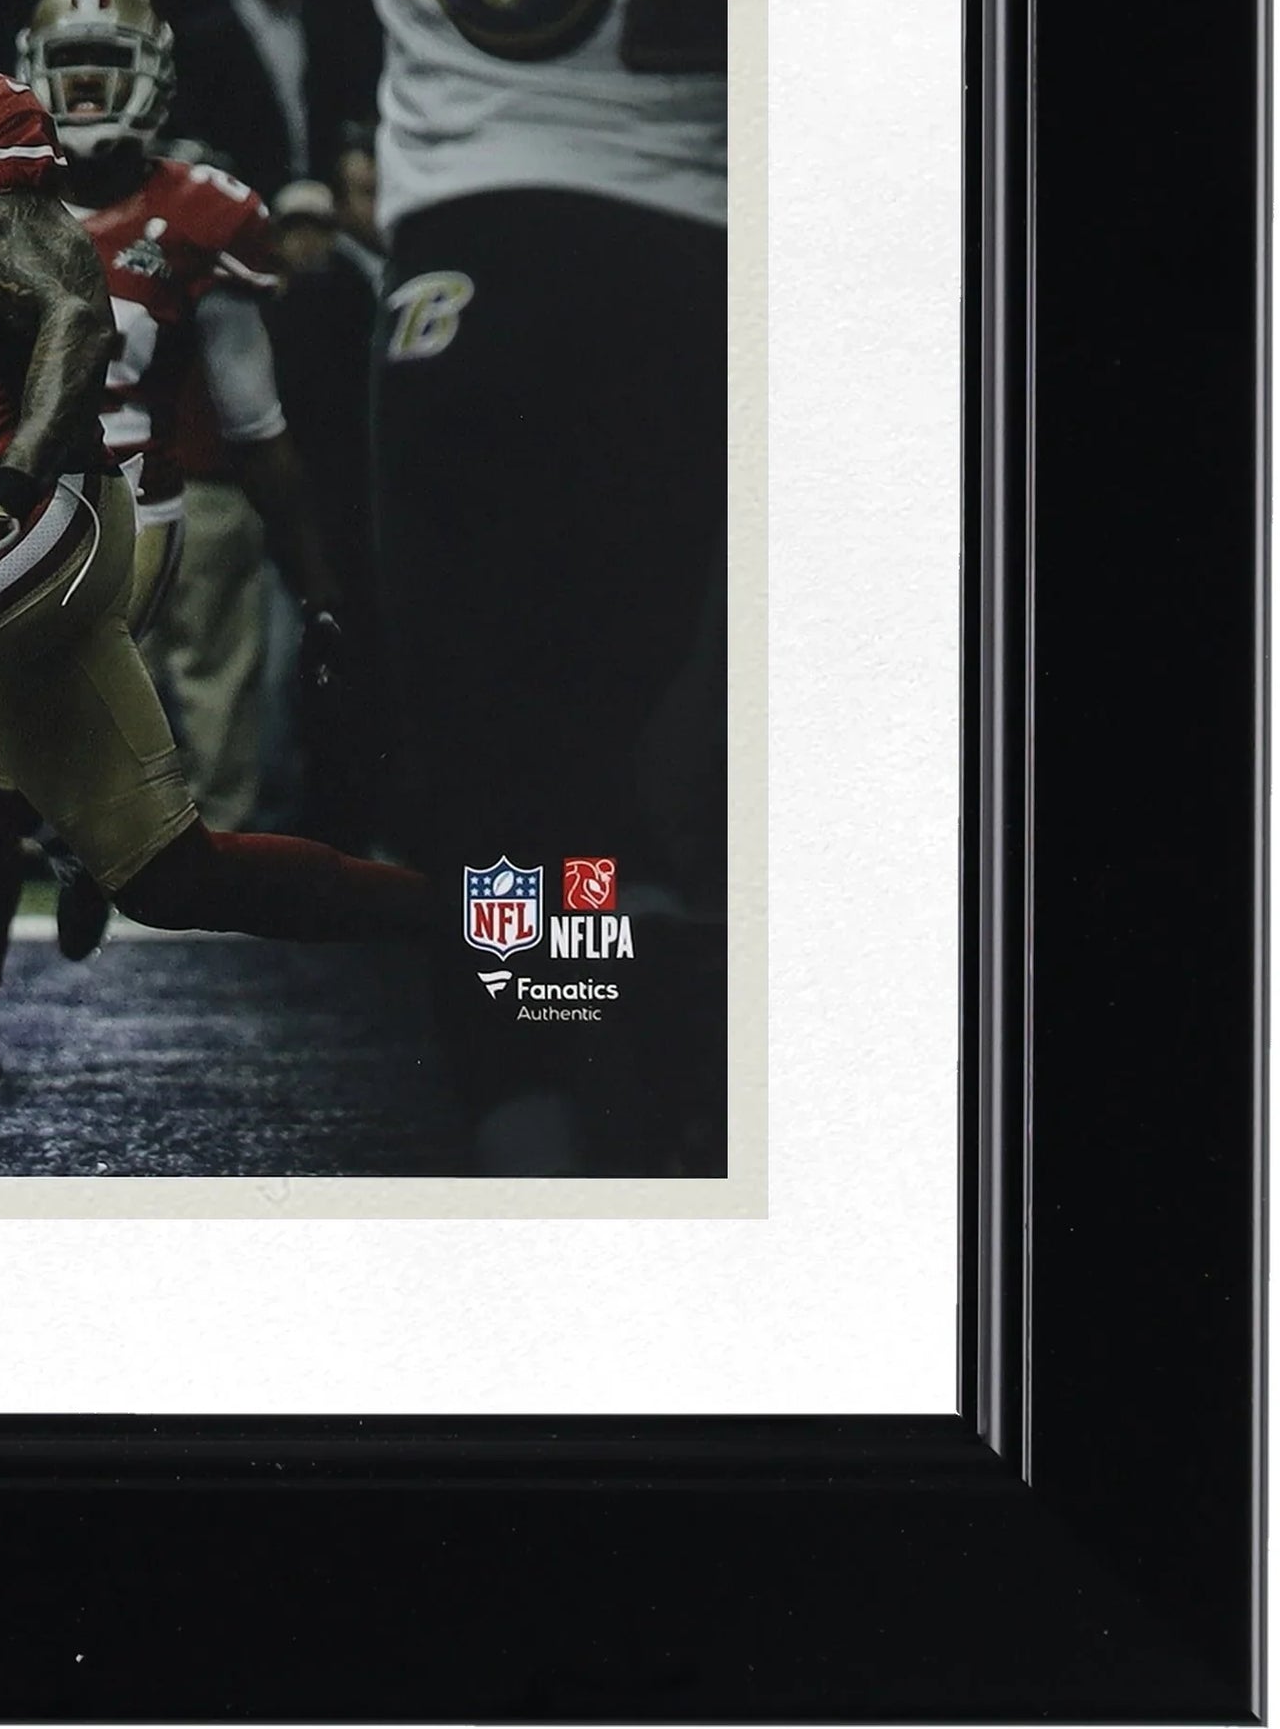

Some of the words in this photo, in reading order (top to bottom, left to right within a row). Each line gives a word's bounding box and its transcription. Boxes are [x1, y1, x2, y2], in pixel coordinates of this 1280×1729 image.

[473, 901, 534, 946] NFL
[549, 914, 635, 959] NFLPA
[516, 976, 621, 1002] Fanatics
[515, 1005, 603, 1022] Authentic
